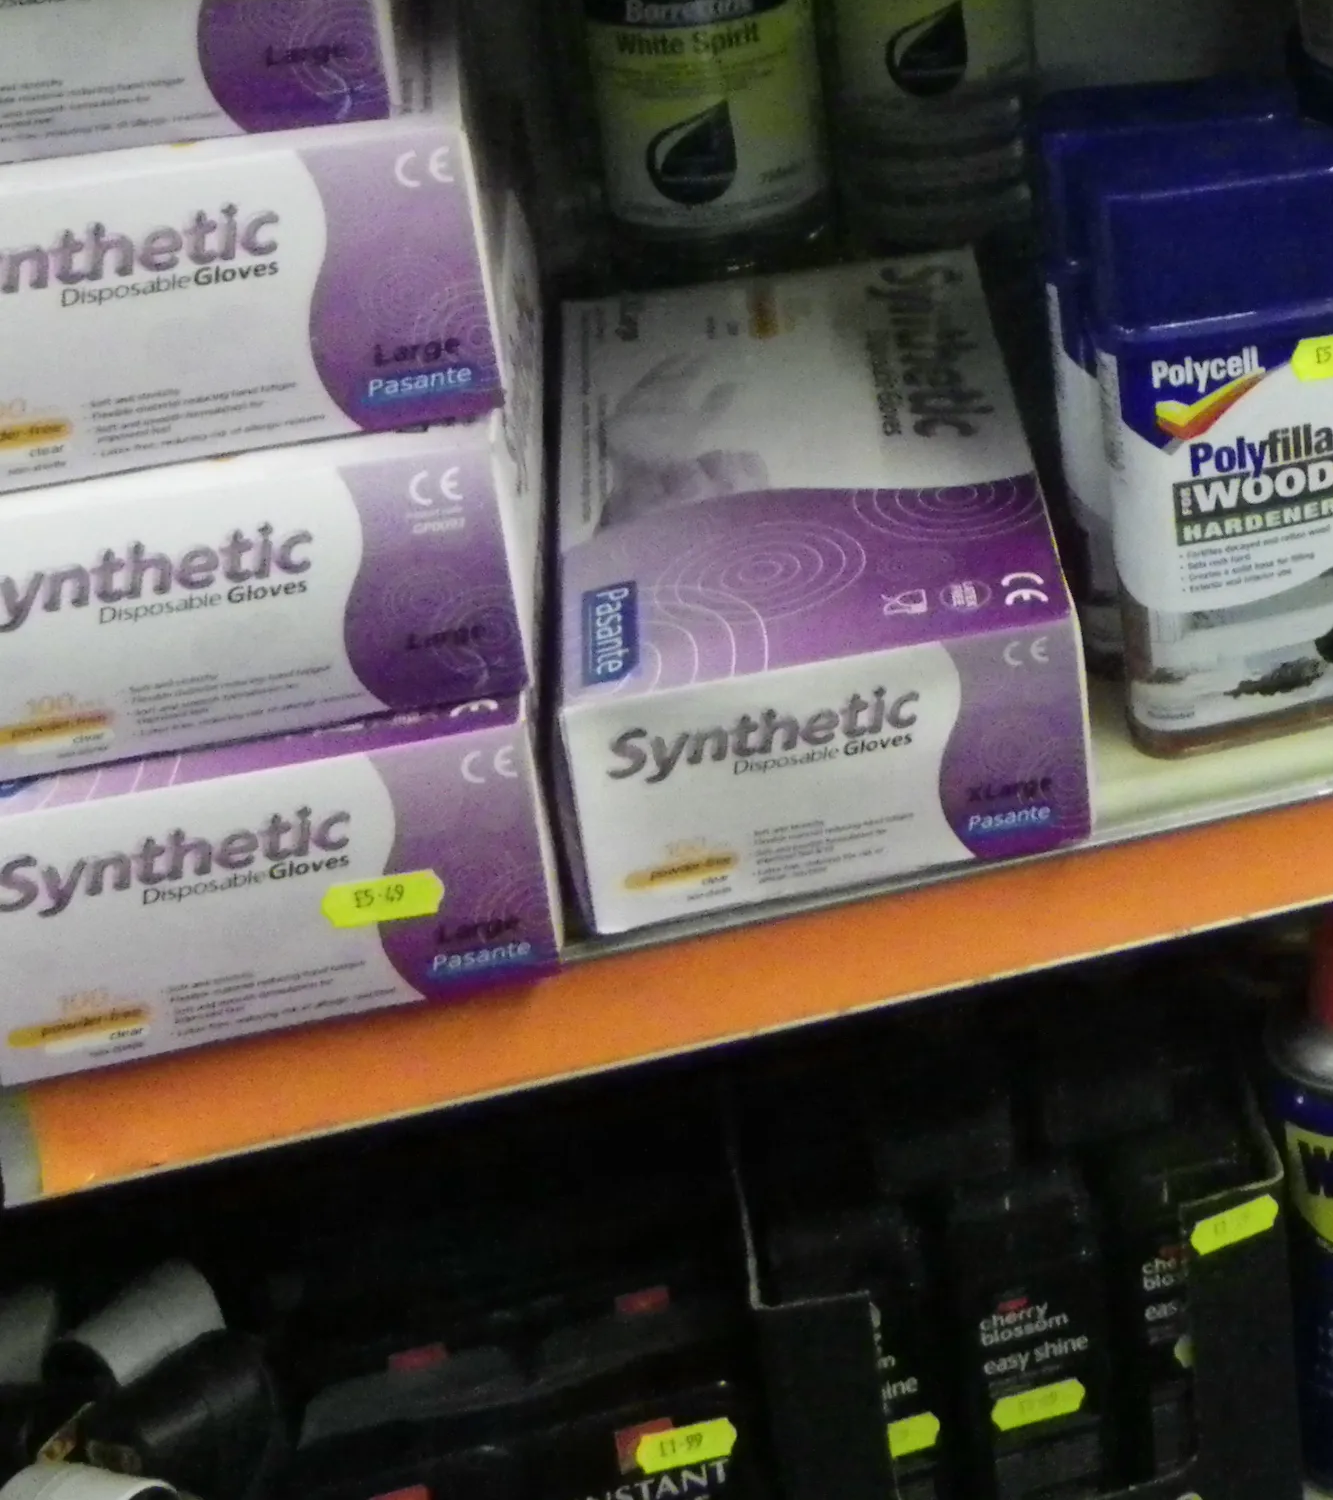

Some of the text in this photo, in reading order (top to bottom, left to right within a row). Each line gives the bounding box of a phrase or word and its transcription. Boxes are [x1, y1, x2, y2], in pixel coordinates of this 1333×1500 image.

[265, 40, 348, 67] Large
[615, 19, 760, 58] White Spirit
[0, 201, 280, 294] nthetic
[60, 257, 280, 308] Disposable Gloves
[373, 334, 463, 367] Large
[1151, 346, 1266, 393] Polycell
[367, 364, 474, 400] Pasante
[0, 522, 314, 633] ynthetic
[98, 576, 308, 626] Disposable Gloves
[593, 586, 626, 678] Pasante
[605, 685, 921, 785] Synthetic
[733, 730, 914, 777] Disposable Gloves
[967, 805, 1052, 832] Pasante
[0, 805, 351, 918] Synthetic
[141, 853, 350, 907] Disposable Gloves
[432, 915, 519, 946] Large
[432, 939, 532, 972] Pasante
[979, 1300, 1049, 1332] cherry
[979, 1311, 1070, 1347] blossom
[982, 1331, 1090, 1377] easy shine
